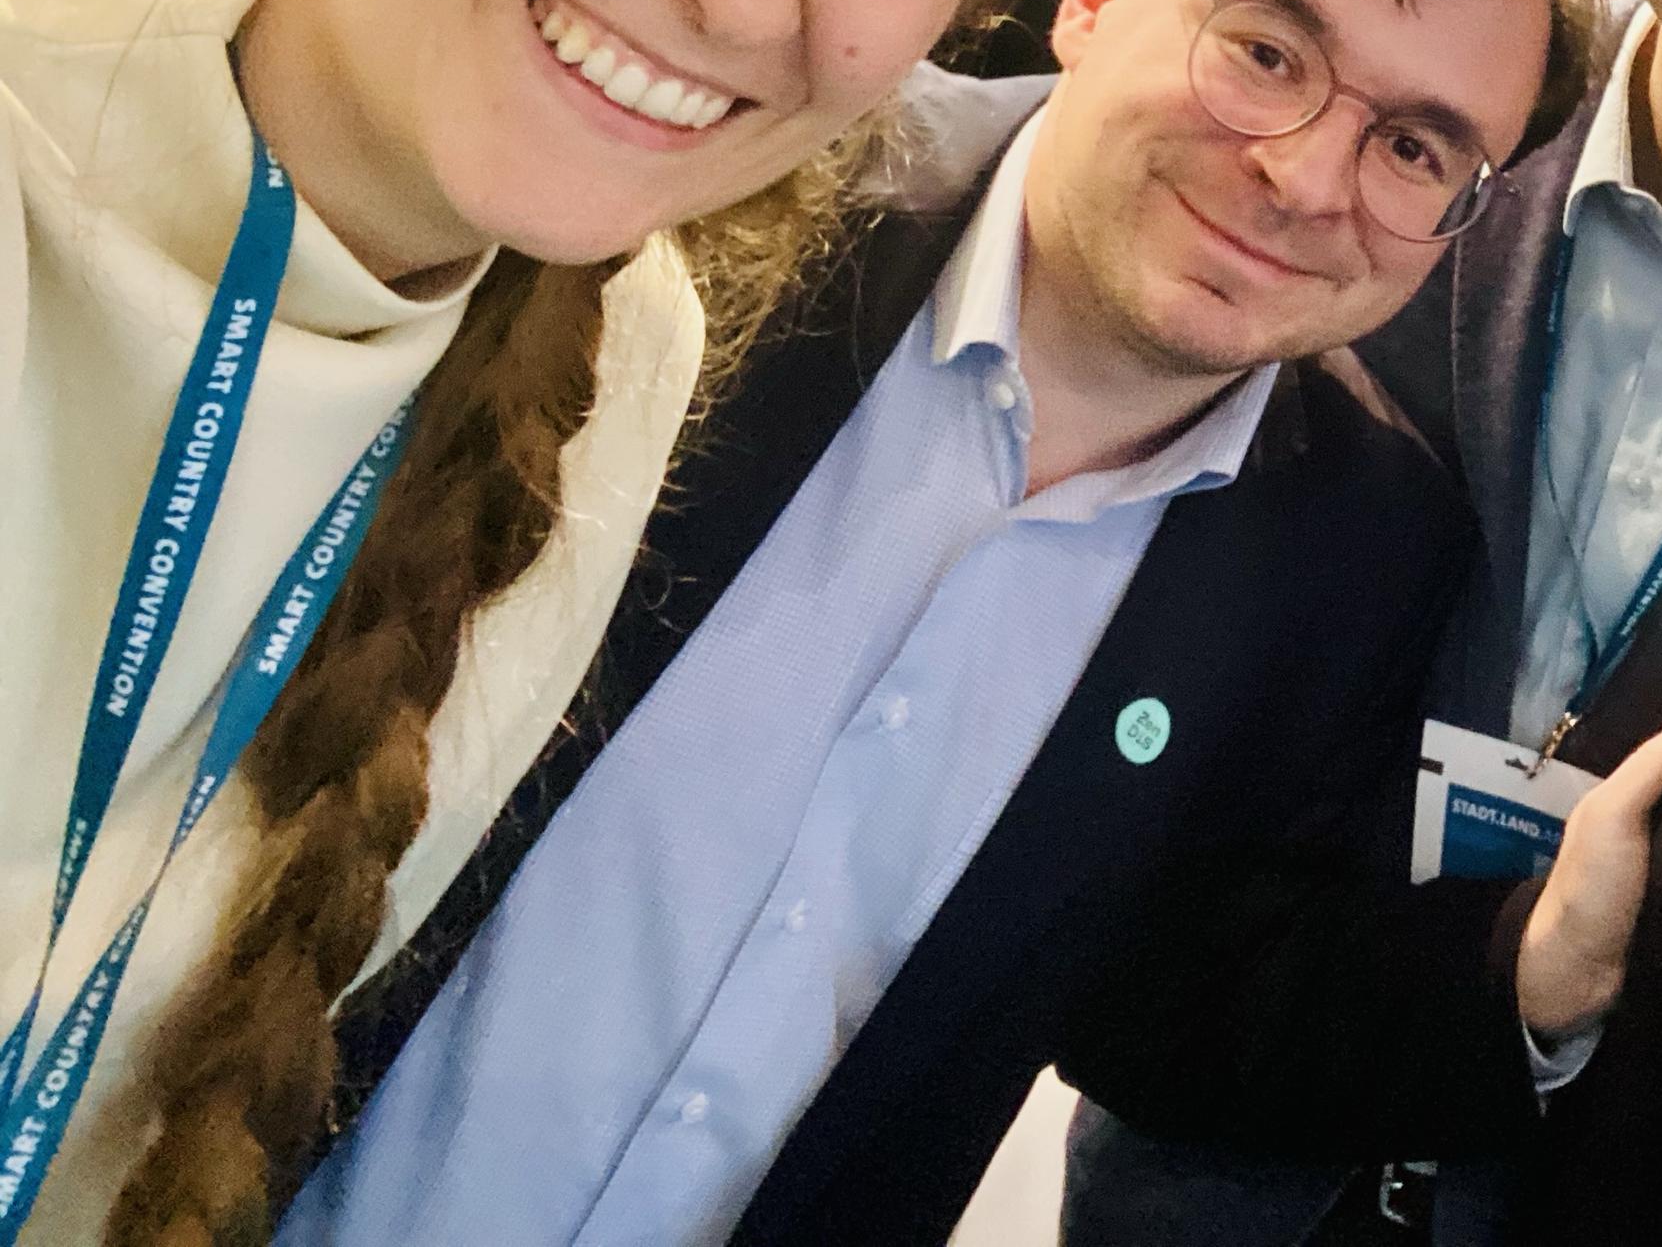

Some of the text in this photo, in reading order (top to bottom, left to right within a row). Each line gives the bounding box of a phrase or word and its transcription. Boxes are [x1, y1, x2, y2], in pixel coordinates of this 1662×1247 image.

[105, 297, 256, 719] SMART COUNTRY CONVENTION
[258, 583, 315, 676] SMART
[305, 461, 377, 581] COUNTRY
[37, 970, 109, 1110] COUNTRY
